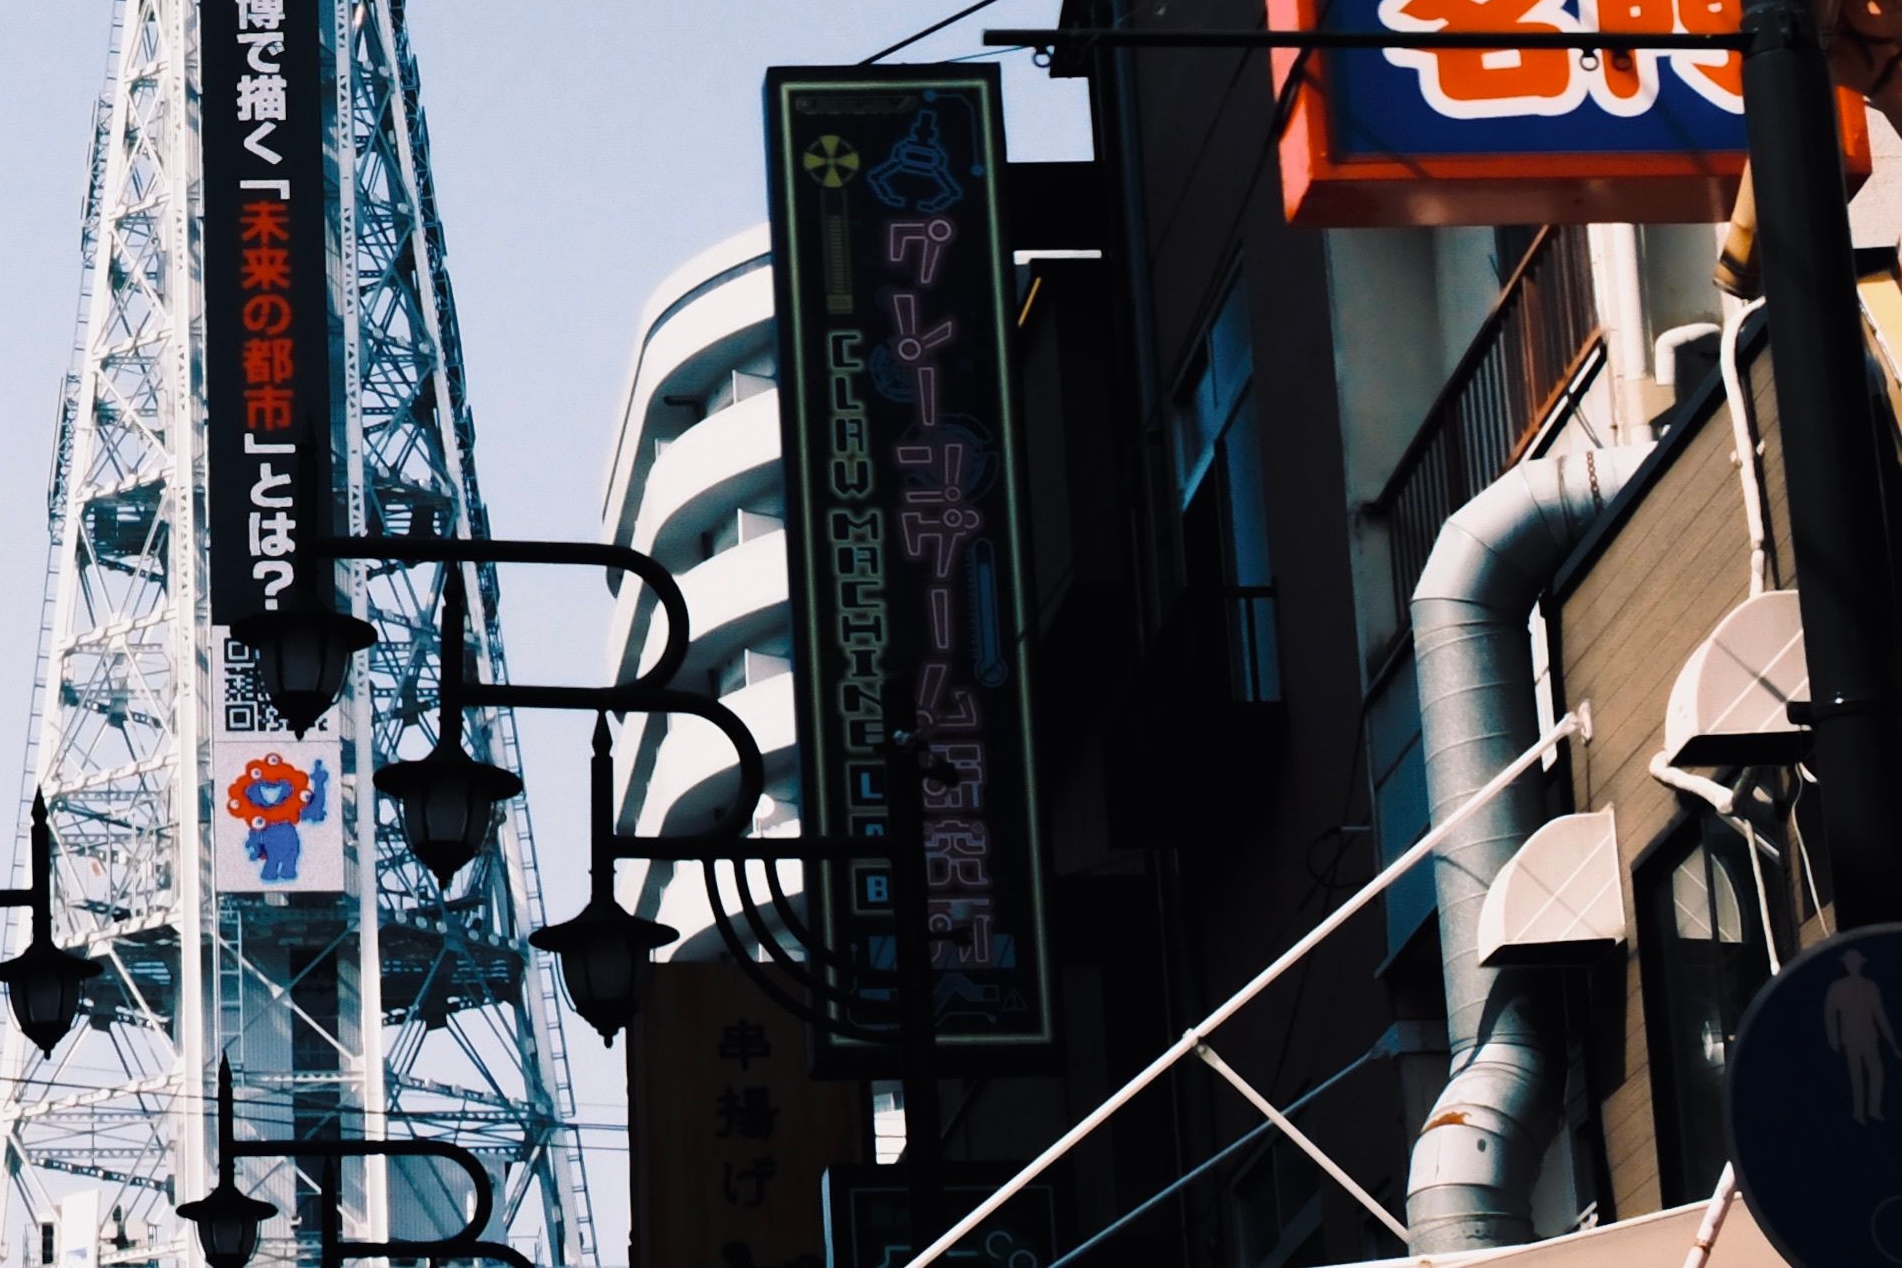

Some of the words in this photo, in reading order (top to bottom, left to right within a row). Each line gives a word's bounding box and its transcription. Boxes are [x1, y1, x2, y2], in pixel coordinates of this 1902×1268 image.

[828, 331, 873, 498] CLAW
[831, 511, 888, 752] MACHINE
[714, 1019, 781, 1207] 串揚げ
